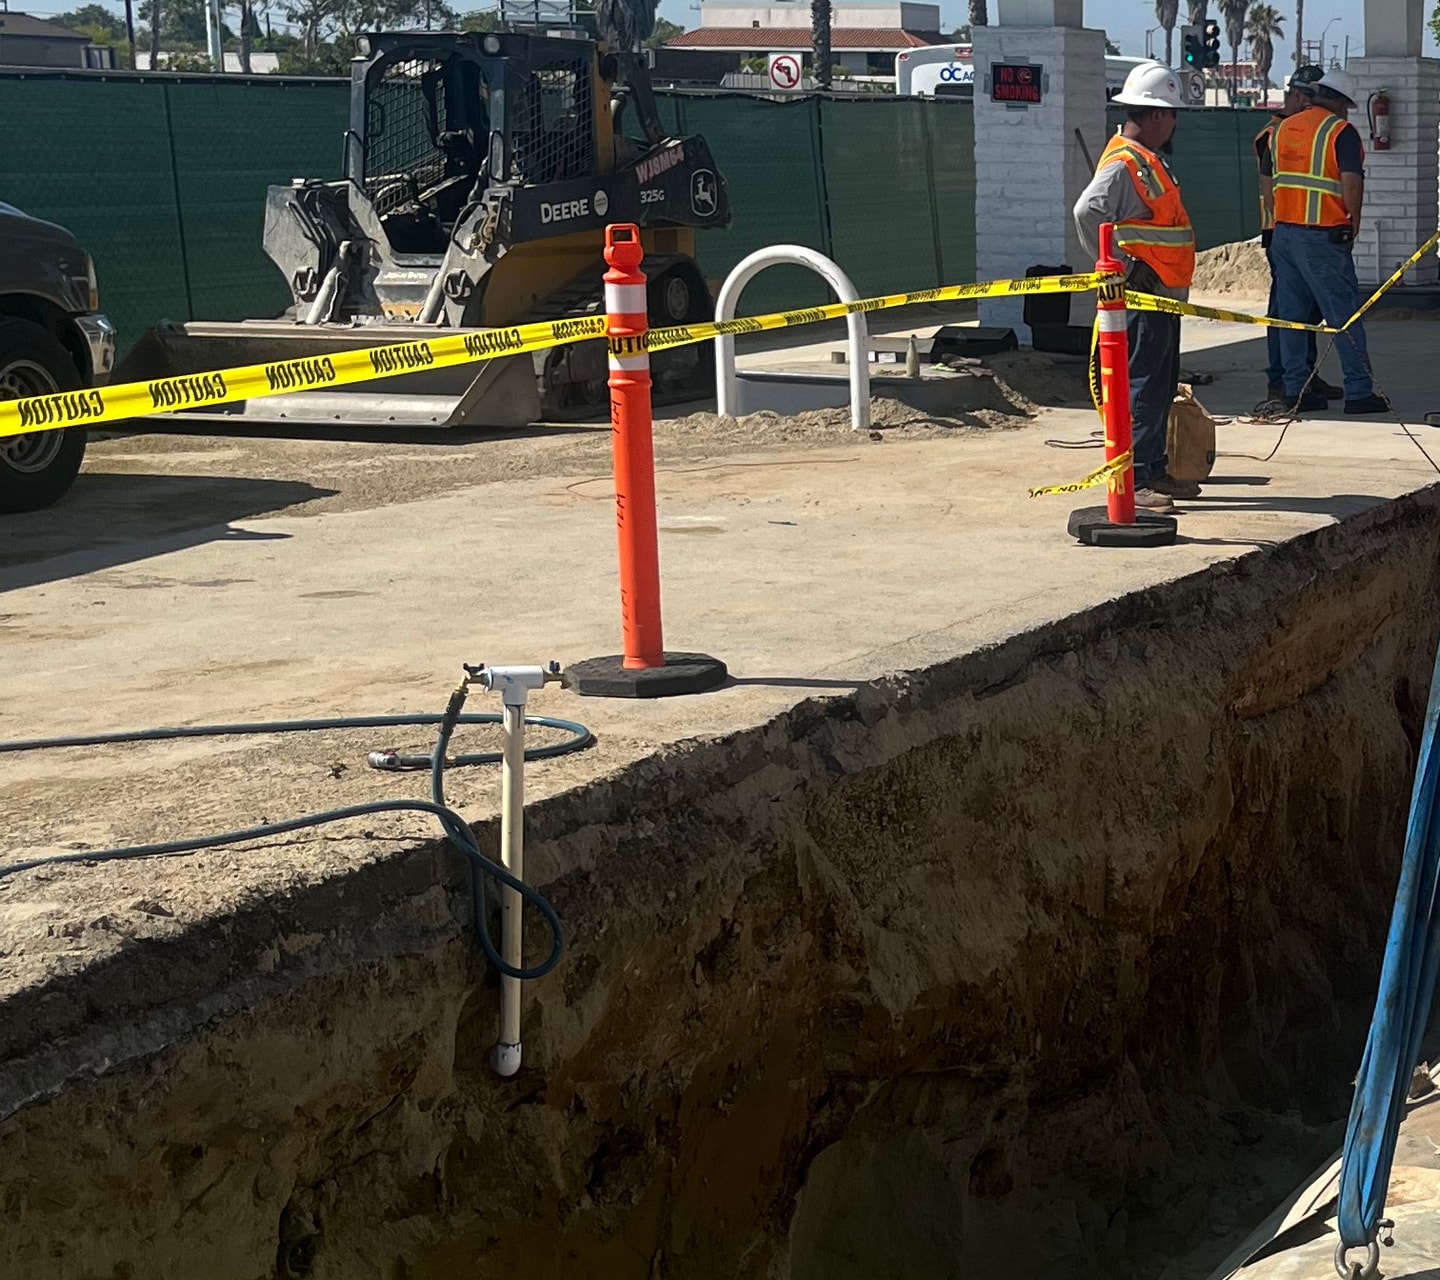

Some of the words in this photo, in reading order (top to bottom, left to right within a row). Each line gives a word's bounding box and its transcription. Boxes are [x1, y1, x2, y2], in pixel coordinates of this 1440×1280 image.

[1000, 67, 1014, 82] NO
[995, 84, 1039, 100] SMOKING
[640, 189, 665, 204] 325G
[541, 198, 590, 224] DEERE
